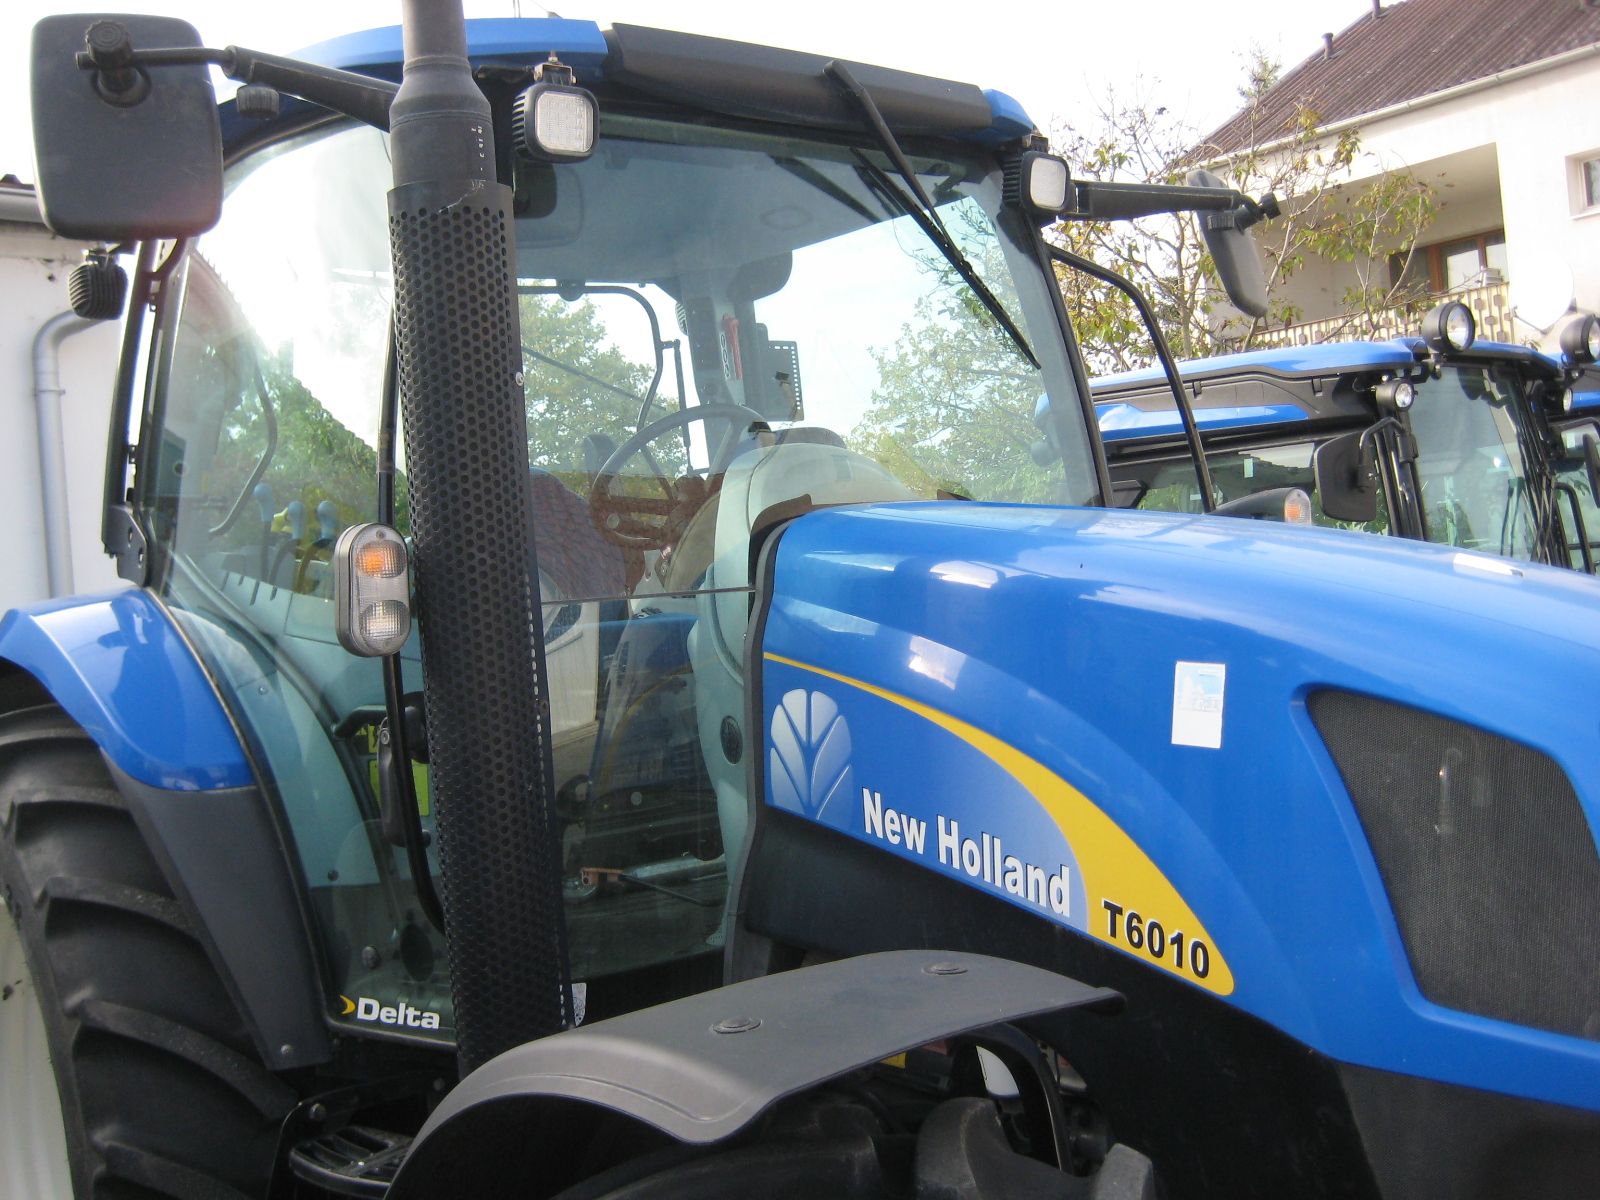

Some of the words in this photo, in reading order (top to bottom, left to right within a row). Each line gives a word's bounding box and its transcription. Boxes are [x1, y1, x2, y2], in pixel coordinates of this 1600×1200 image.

[862, 787, 926, 855] New
[937, 814, 1070, 918] Holland
[1102, 899, 1209, 979] T6010
[357, 997, 440, 1029] Delta
